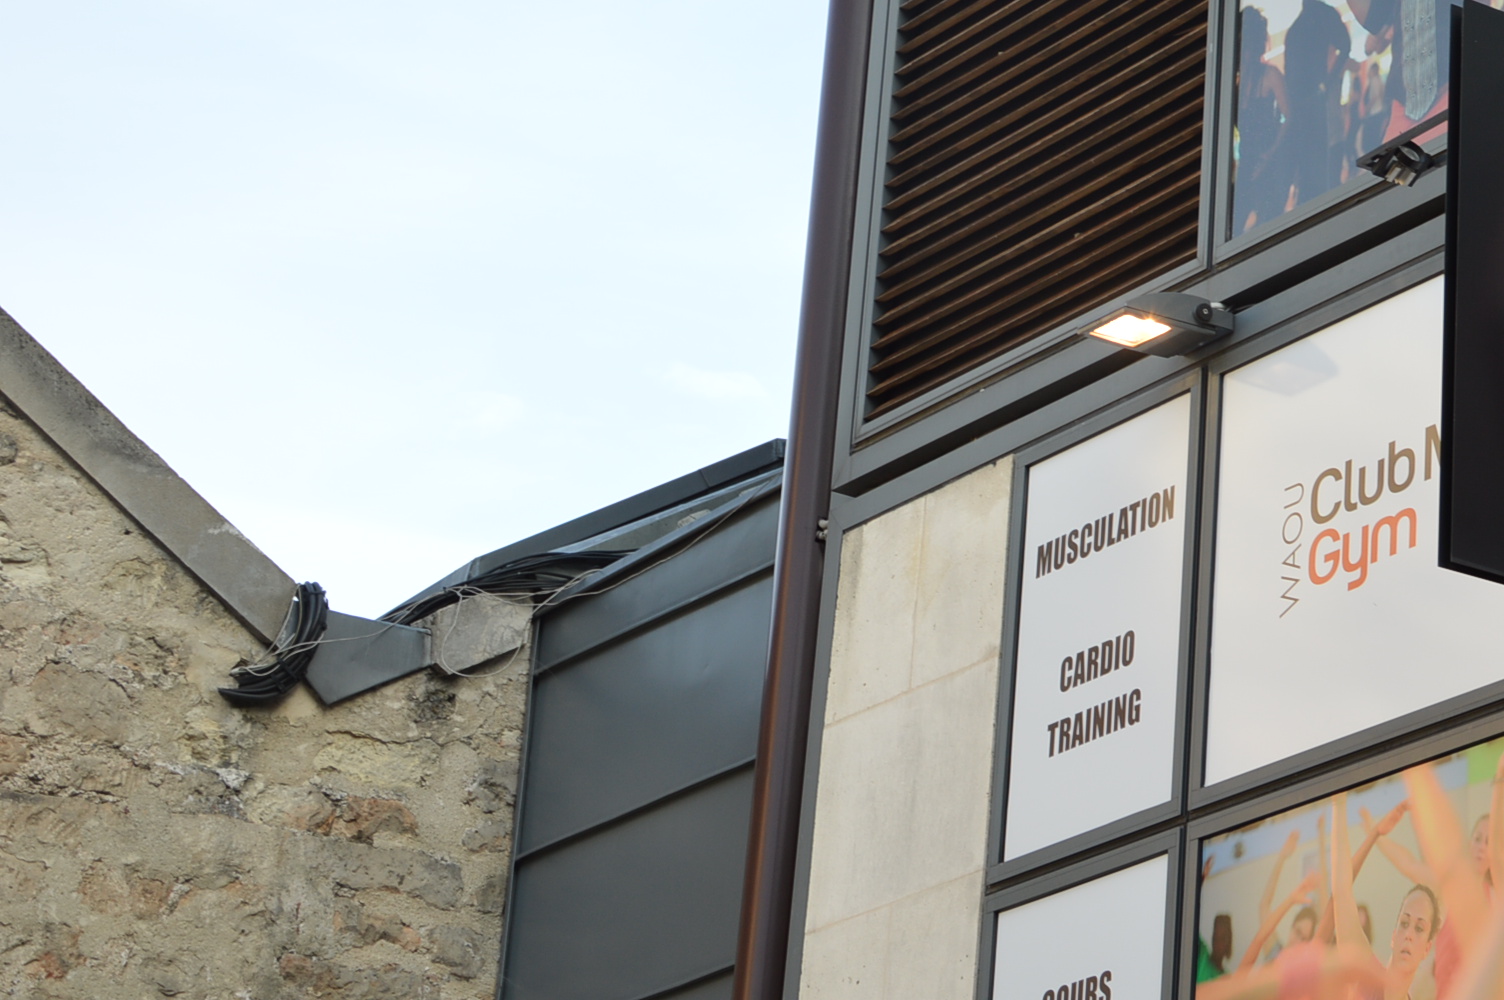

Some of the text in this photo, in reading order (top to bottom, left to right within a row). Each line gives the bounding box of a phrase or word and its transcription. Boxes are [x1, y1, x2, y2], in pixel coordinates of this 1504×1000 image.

[1309, 439, 1417, 525] Club
[1034, 484, 1177, 580] MUSCULATION
[1278, 481, 1305, 619] WAOU
[1307, 507, 1418, 592] Gym
[1058, 629, 1136, 693] CARDIO
[1046, 688, 1142, 759] TRAINING
